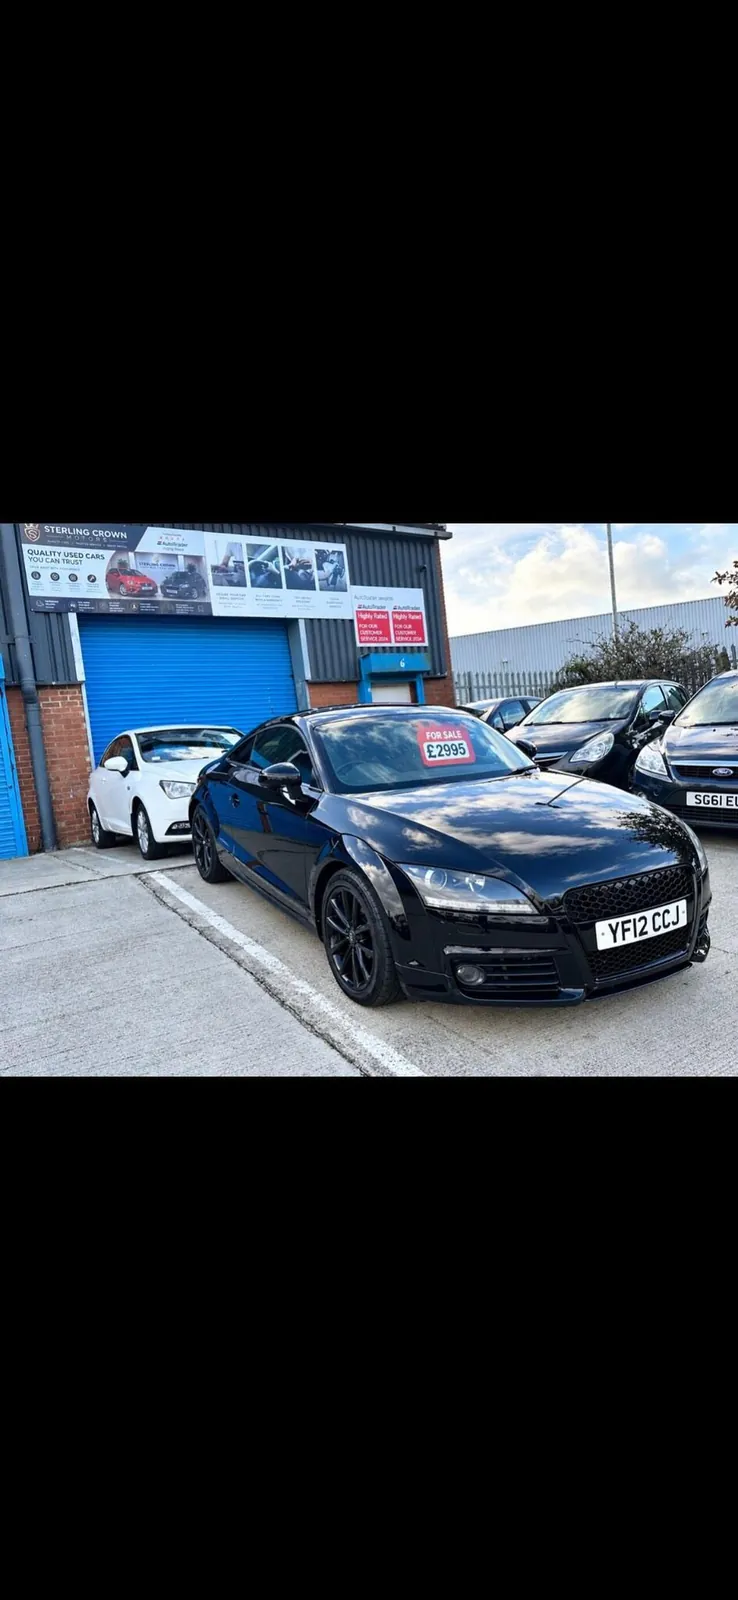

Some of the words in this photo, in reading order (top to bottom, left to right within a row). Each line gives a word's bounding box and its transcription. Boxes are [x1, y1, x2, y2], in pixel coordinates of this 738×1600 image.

[44, 525, 90, 537] STERLING
[92, 528, 128, 540] CROWN
[66, 534, 108, 542] MOTORS
[27, 549, 62, 558] QUALITY
[63, 551, 84, 559] USED
[85, 552, 105, 560] CARS
[358, 612, 373, 621] Highly
[374, 612, 388, 620] Rated
[393, 613, 407, 621] Highly
[400, 657, 406, 668] 6
[425, 731, 442, 740] FOR
[443, 730, 463, 739] SALE
[427, 743, 466, 758] £2995
[695, 794, 722, 806] SG61
[607, 915, 649, 944] YF12
[651, 904, 680, 933] CCJ
